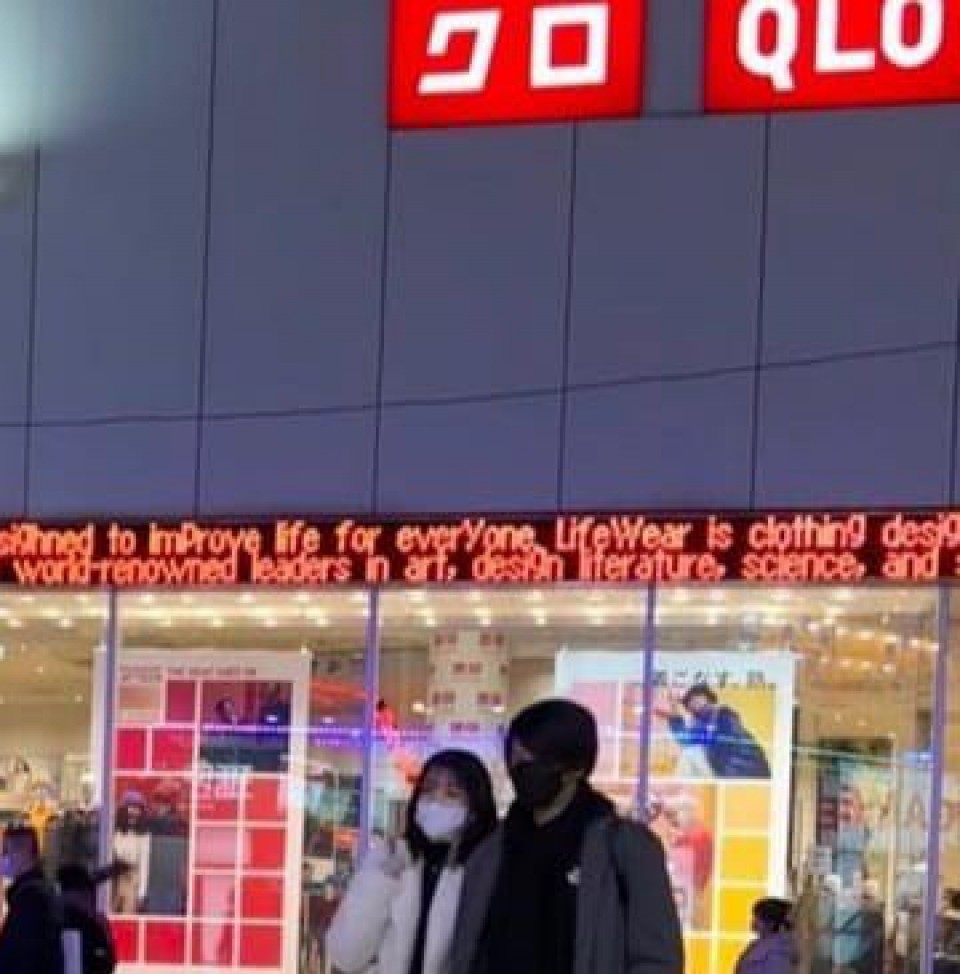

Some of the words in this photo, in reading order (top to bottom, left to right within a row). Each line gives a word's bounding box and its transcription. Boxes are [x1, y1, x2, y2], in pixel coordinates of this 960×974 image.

[416, 3, 609, 96] クロ
[738, 0, 945, 92] QLO
[107, 522, 136, 554] to
[275, 520, 320, 553] life
[336, 520, 382, 553] for
[706, 514, 734, 550] is
[882, 545, 939, 578] and
